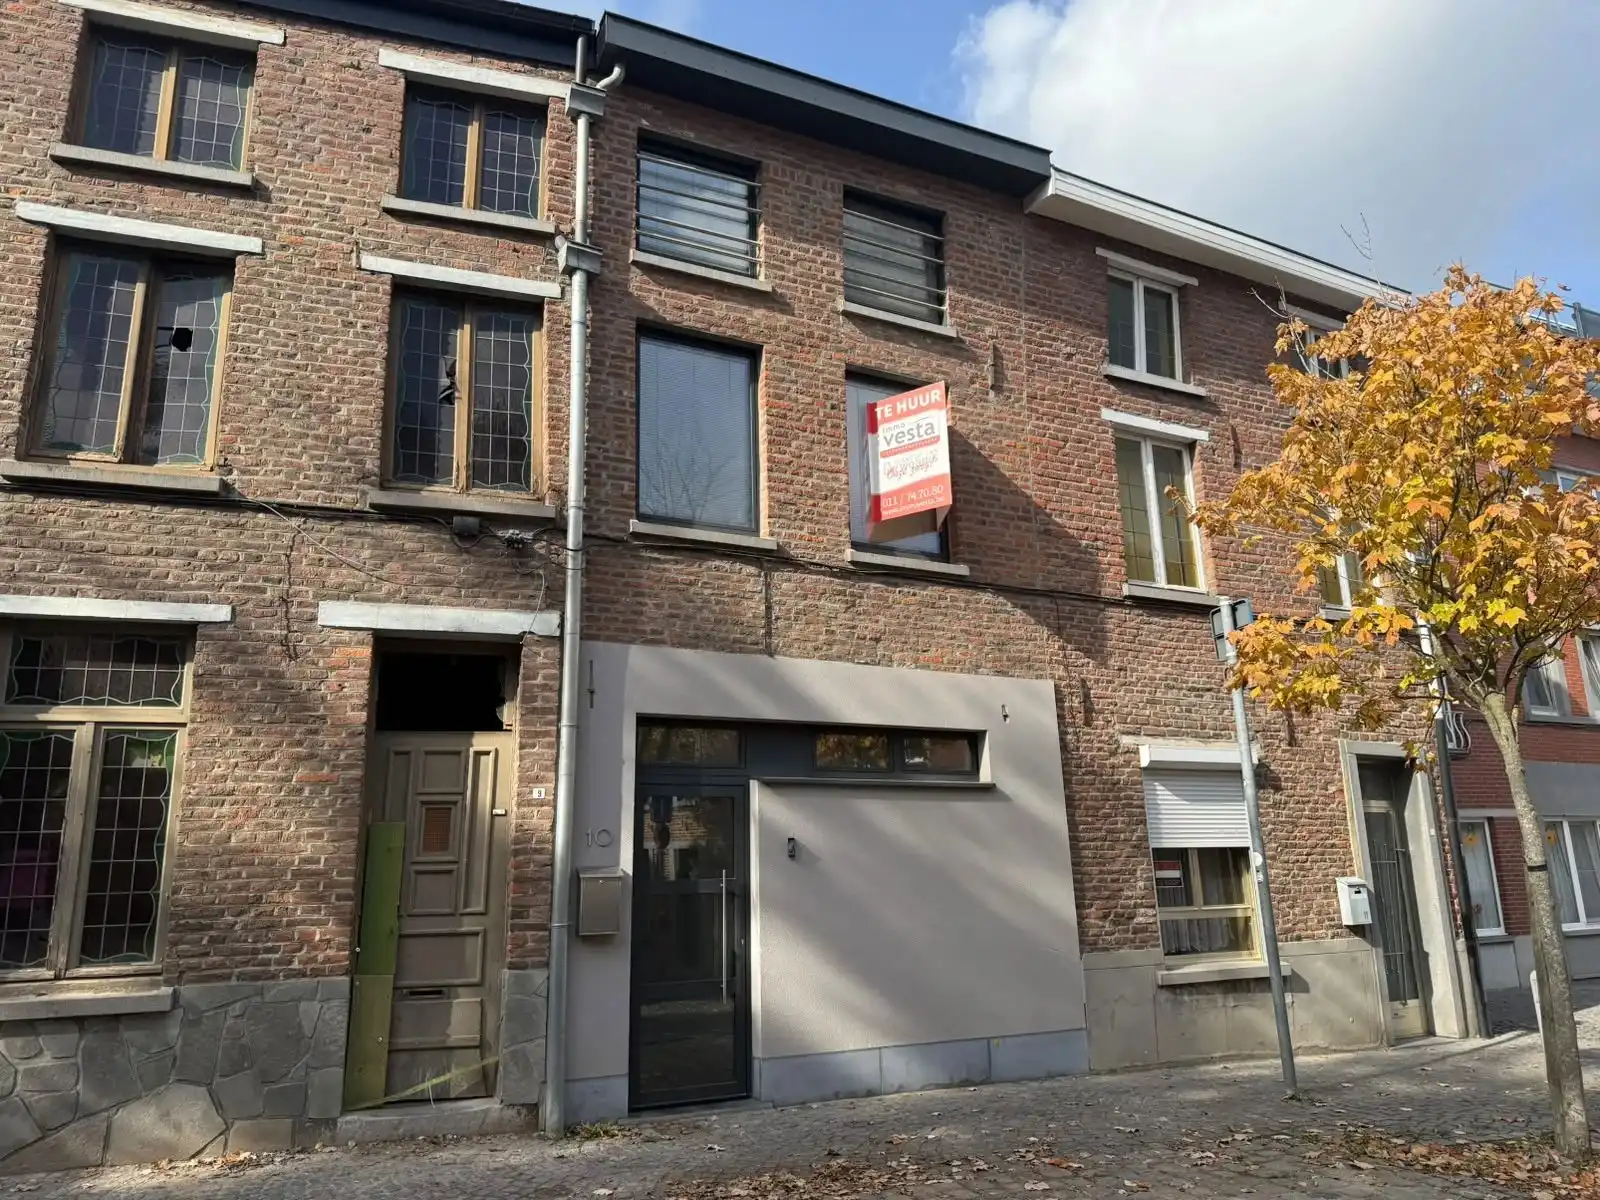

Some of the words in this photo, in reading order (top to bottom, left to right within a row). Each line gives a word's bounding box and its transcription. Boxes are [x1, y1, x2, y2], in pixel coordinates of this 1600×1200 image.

[875, 404, 892, 420] TE
[897, 389, 941, 415] HUUR
[884, 422, 935, 447] vesta
[585, 827, 614, 848] 10
